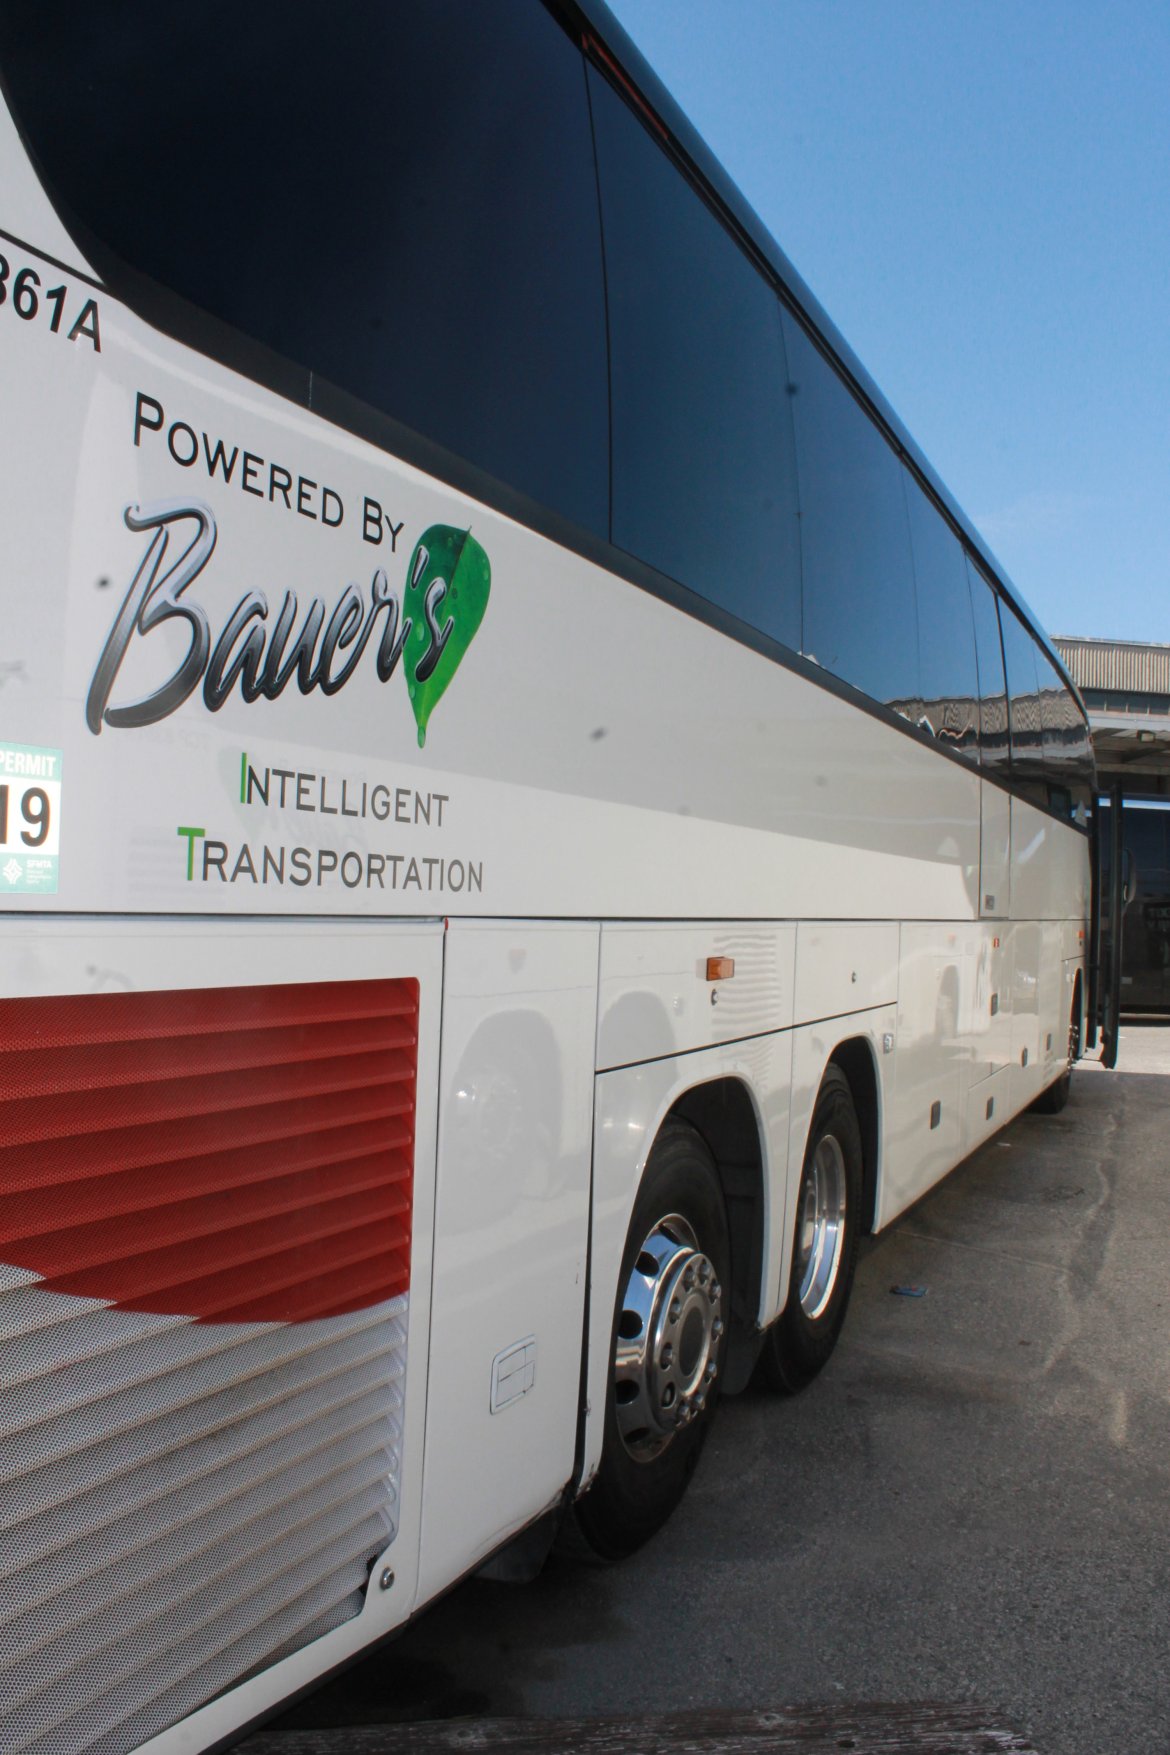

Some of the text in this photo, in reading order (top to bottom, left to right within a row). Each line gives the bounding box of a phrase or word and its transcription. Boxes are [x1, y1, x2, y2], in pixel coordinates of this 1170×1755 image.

[134, 391, 405, 553] POWERED BY
[85, 504, 455, 736] Bauer's
[240, 752, 450, 827] INTELLIGENT
[177, 826, 483, 893] TRANSPORTATION
